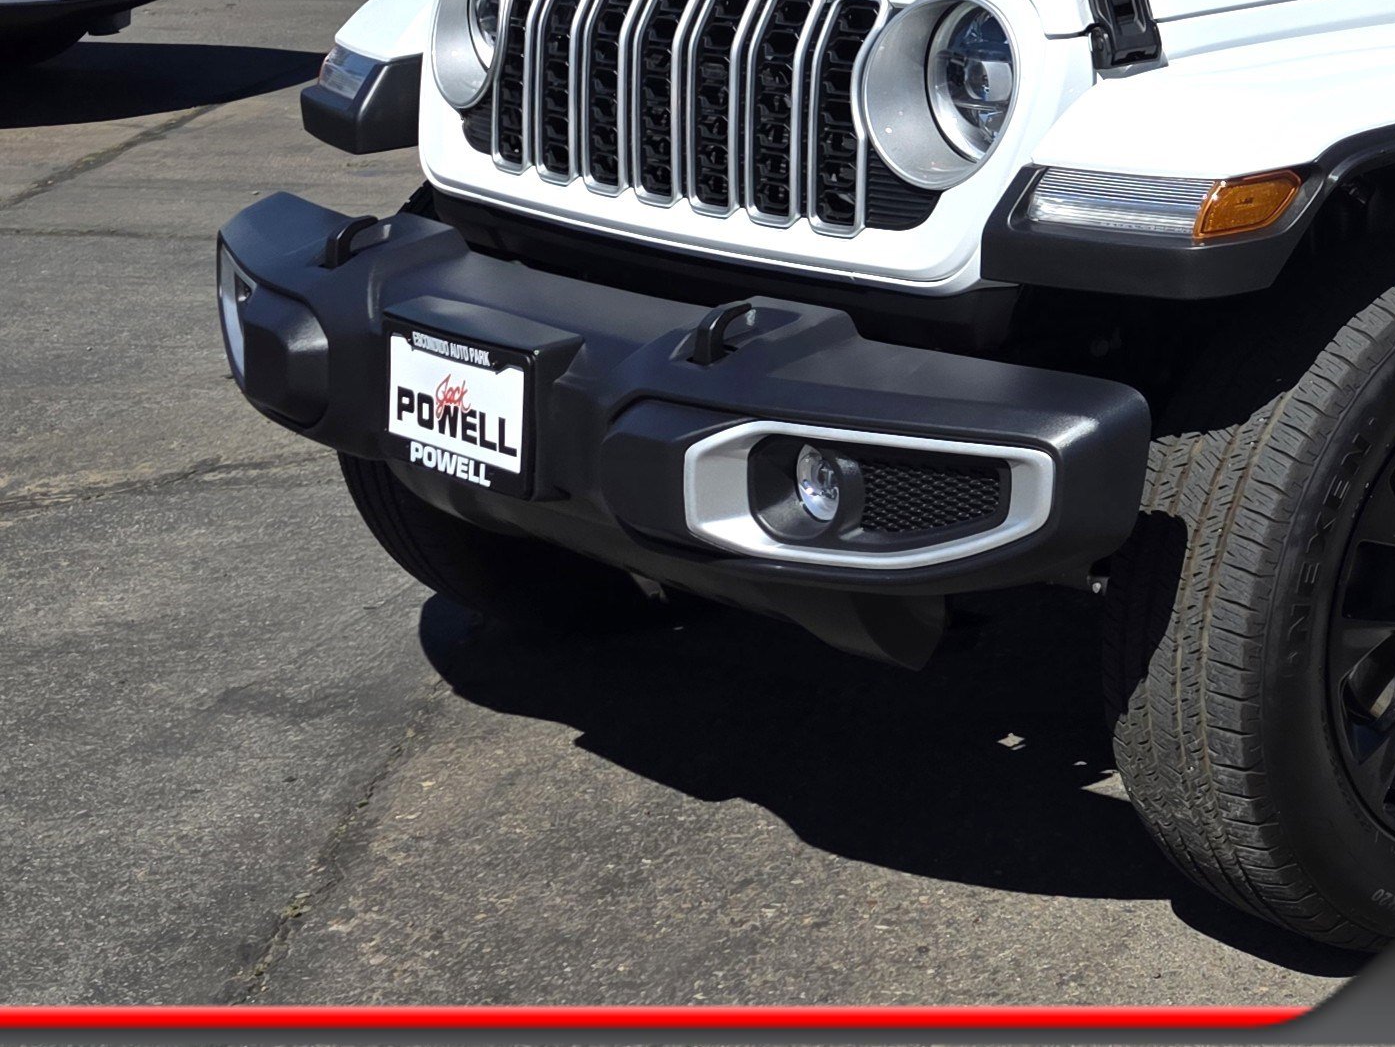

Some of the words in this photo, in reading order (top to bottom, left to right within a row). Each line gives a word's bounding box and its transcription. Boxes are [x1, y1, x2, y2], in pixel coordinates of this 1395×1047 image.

[411, 330, 450, 357] ESCONDIDO
[450, 342, 469, 362] AUTO
[469, 347, 491, 367] PARK
[435, 373, 472, 421] Jack
[397, 385, 518, 458] POWELL
[409, 440, 492, 488] POWELL
